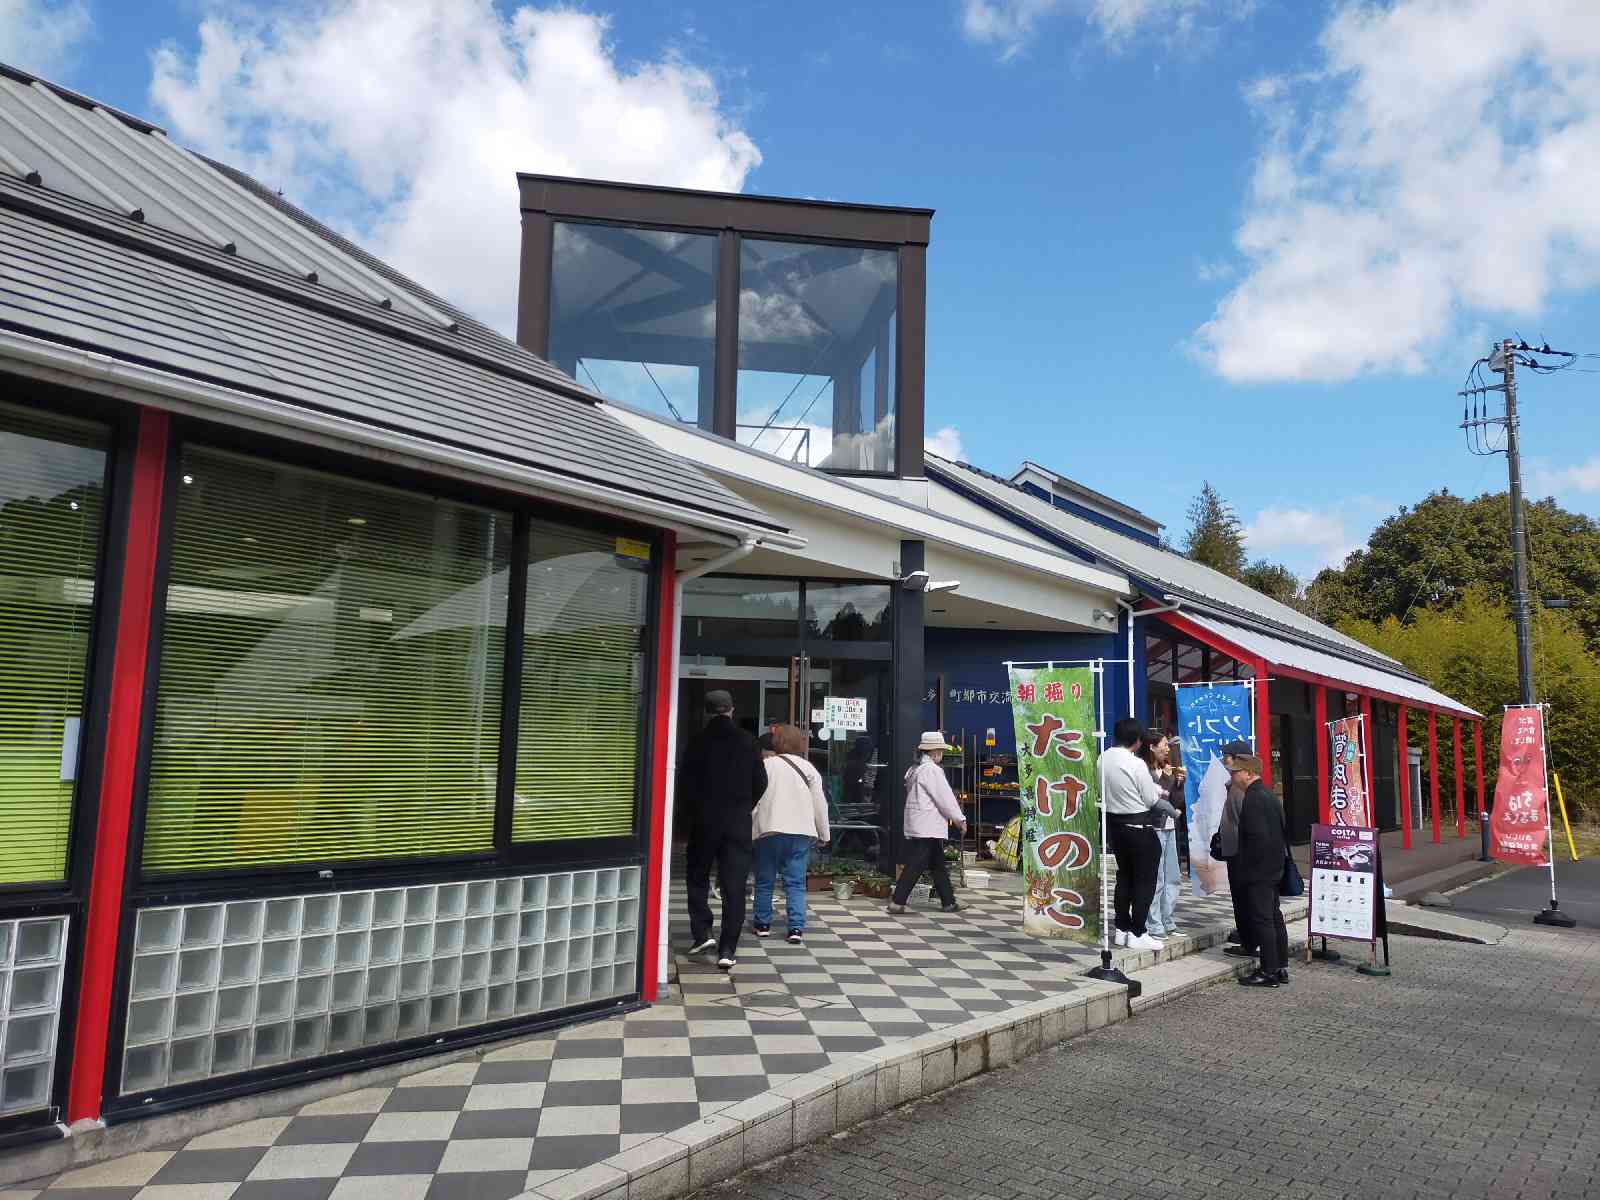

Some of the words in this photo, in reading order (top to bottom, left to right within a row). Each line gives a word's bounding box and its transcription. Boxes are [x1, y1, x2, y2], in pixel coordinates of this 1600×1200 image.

[1016, 682, 1082, 705] 朝掘り
[1026, 713, 1092, 928] たけのこ
[1331, 828, 1356, 837] COSTA
